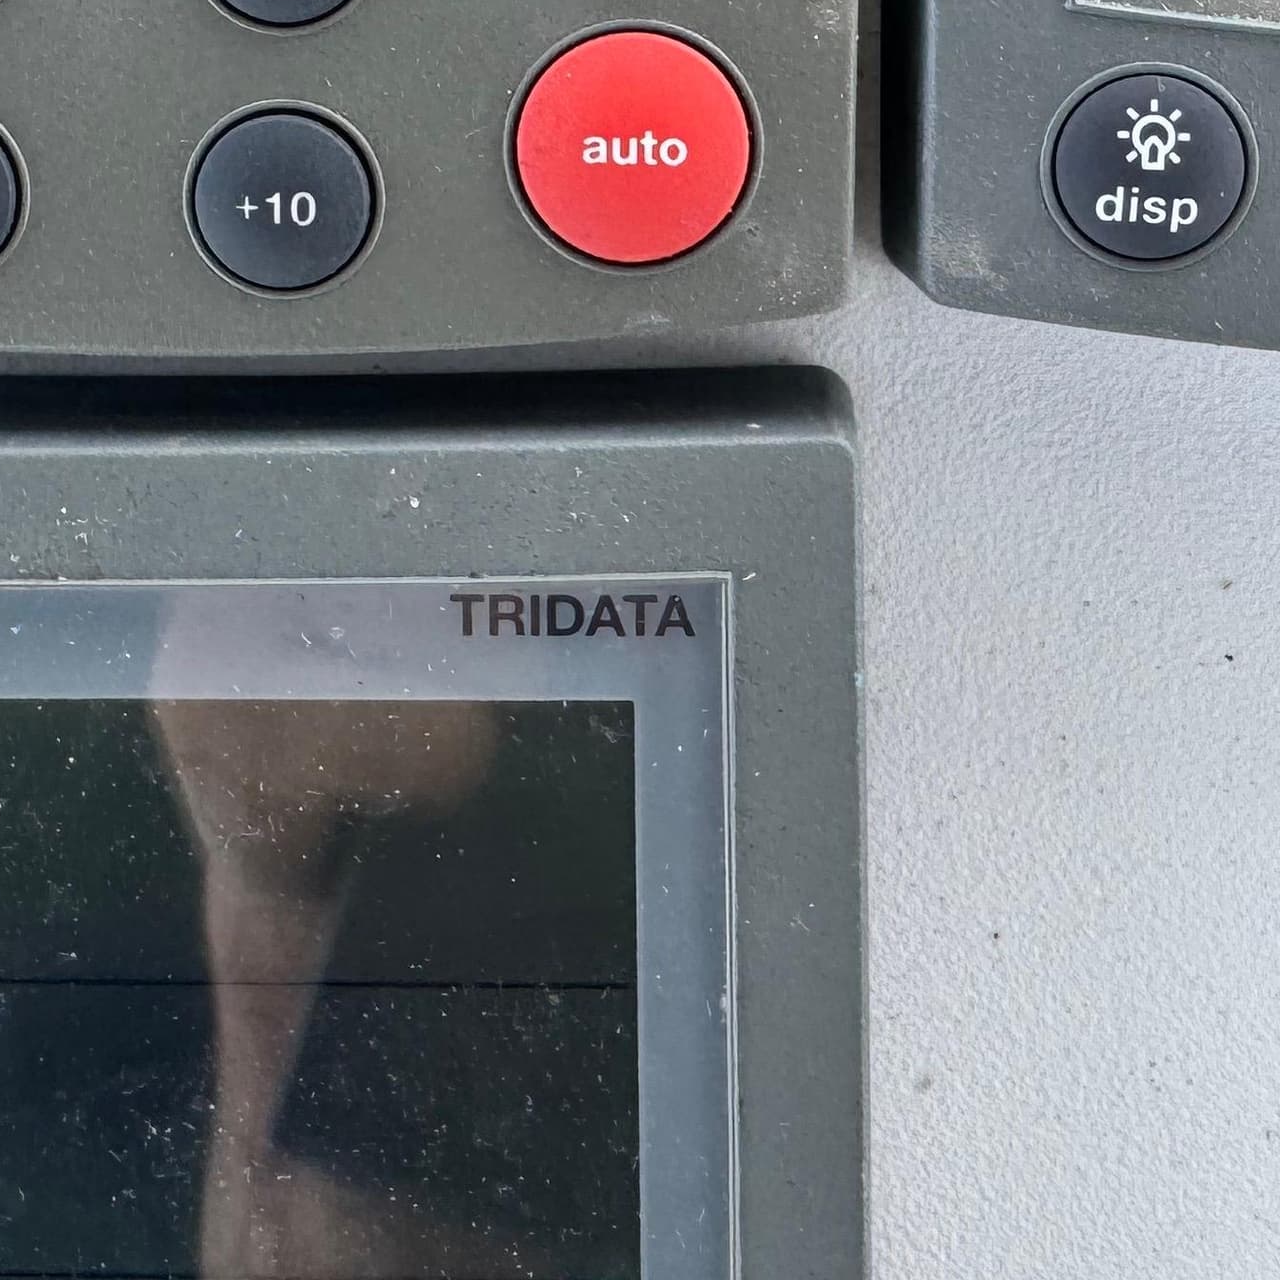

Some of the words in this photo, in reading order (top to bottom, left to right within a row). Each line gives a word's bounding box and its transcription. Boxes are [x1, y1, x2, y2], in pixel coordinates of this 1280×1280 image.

[582, 130, 688, 167] auto
[235, 191, 317, 227] +10
[1095, 186, 1198, 233] disp
[450, 593, 696, 637] TRIDATA
